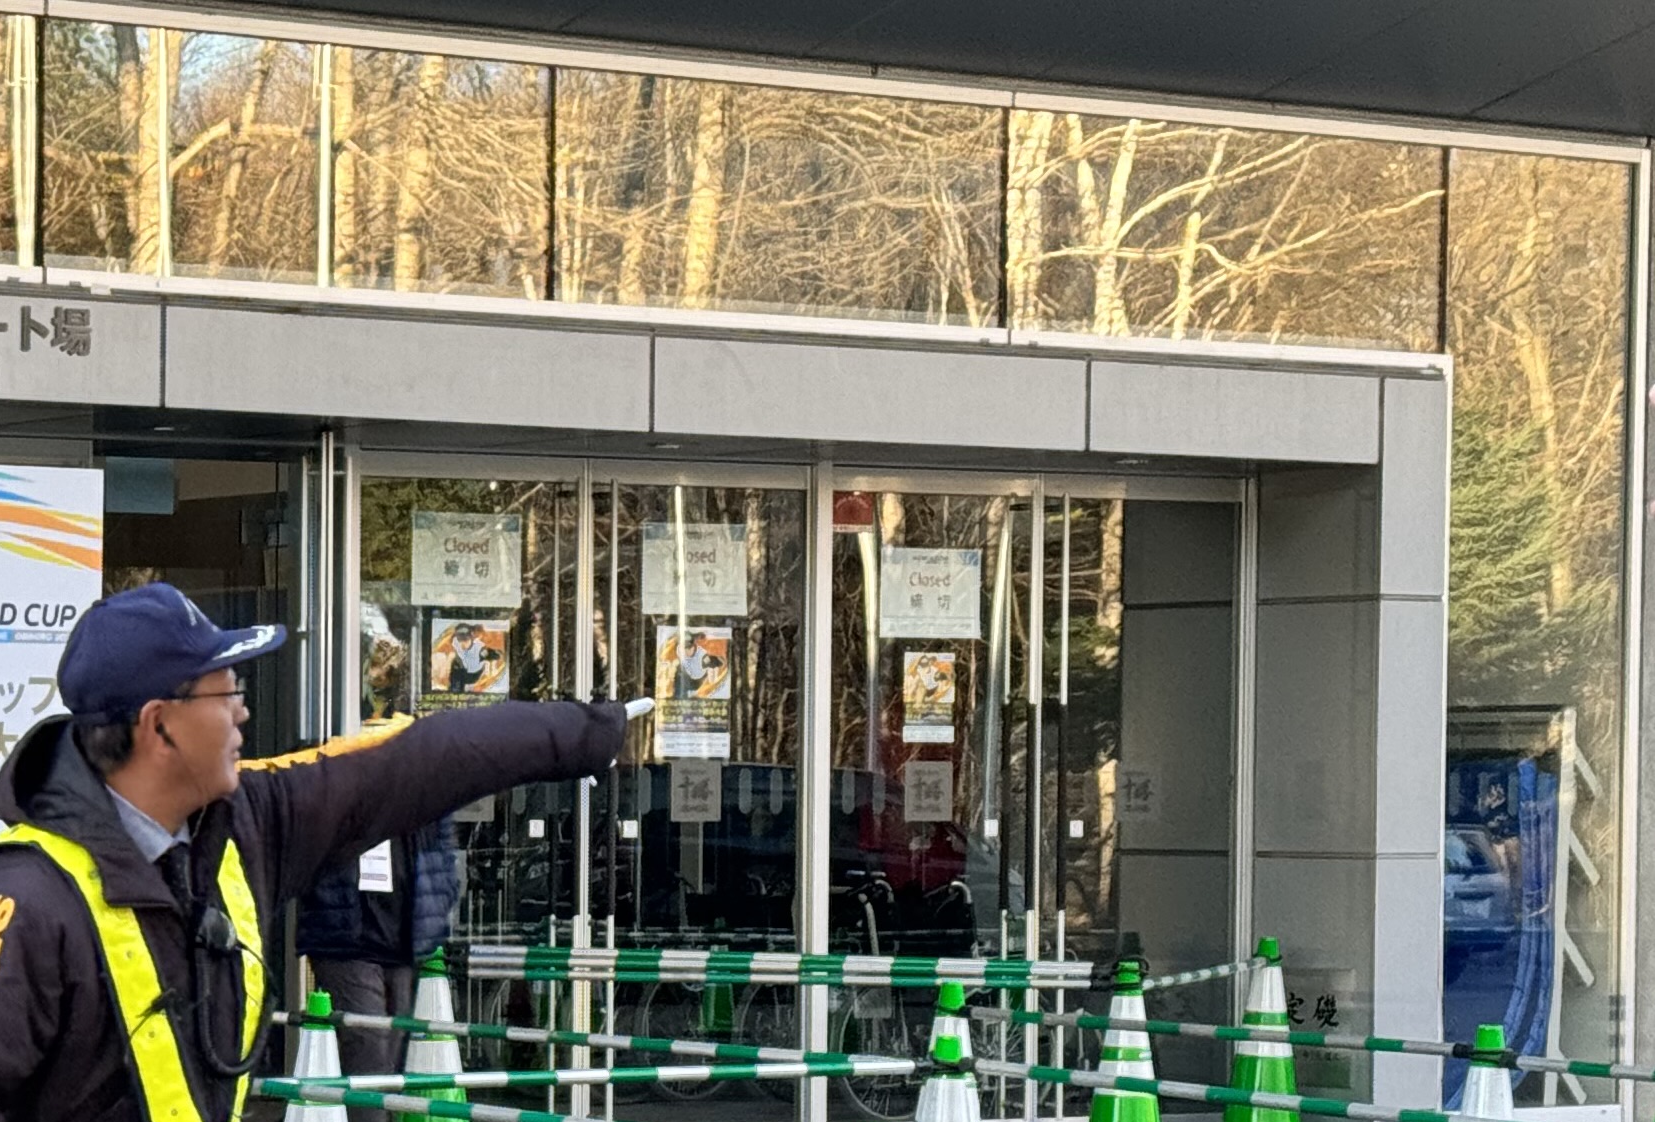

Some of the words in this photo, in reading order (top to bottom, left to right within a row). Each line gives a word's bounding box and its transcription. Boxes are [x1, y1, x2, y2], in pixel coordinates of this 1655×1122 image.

[444, 537, 490, 555] Closed
[909, 571, 952, 588] Closed
[23, 603, 78, 628] CUP
